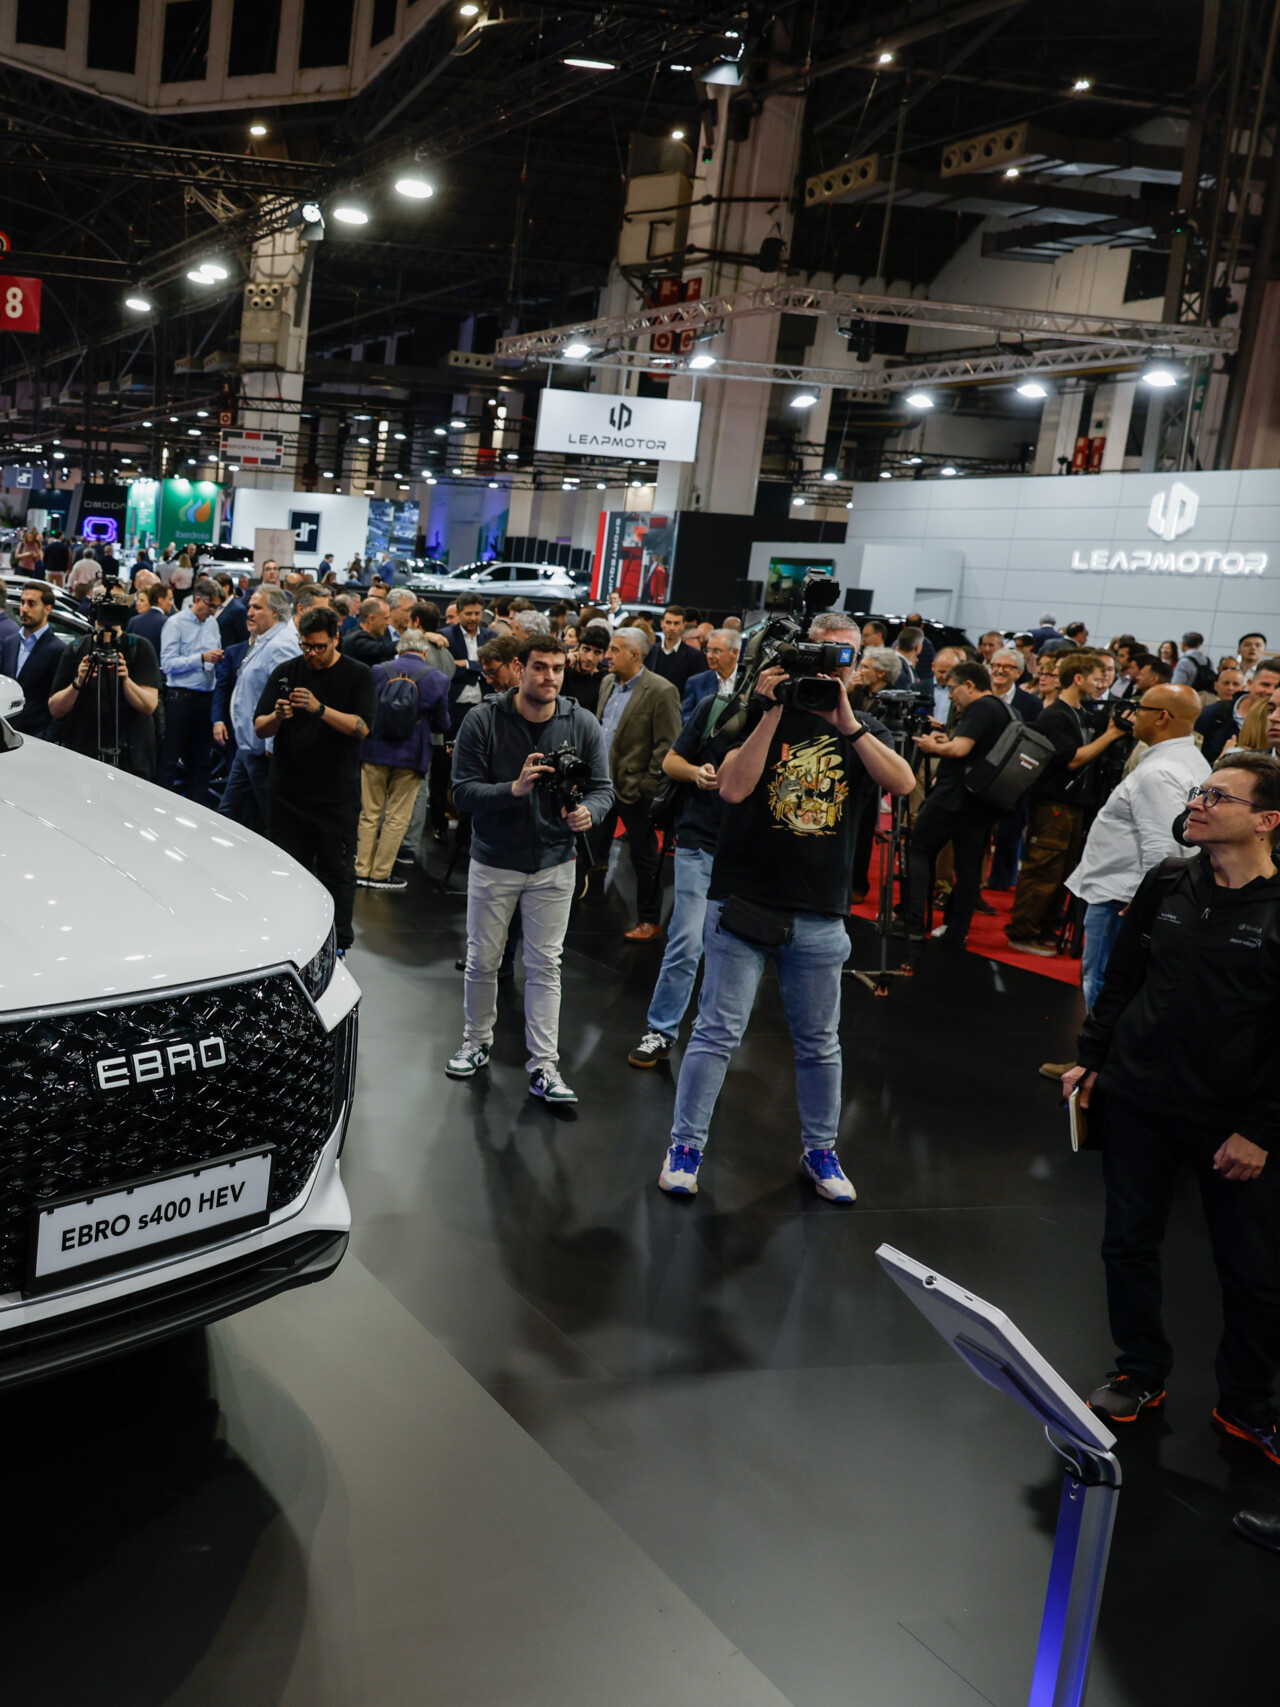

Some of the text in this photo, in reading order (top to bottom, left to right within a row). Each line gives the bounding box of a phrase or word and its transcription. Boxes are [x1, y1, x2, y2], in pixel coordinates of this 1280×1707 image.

[5, 286, 24, 319] 8
[568, 434, 667, 450] LEAPMOTOR
[1071, 550, 1268, 575] LEAPMOTOR
[96, 1036, 226, 1090] EBRO
[61, 1181, 246, 1252] EBRO s400 HEV
